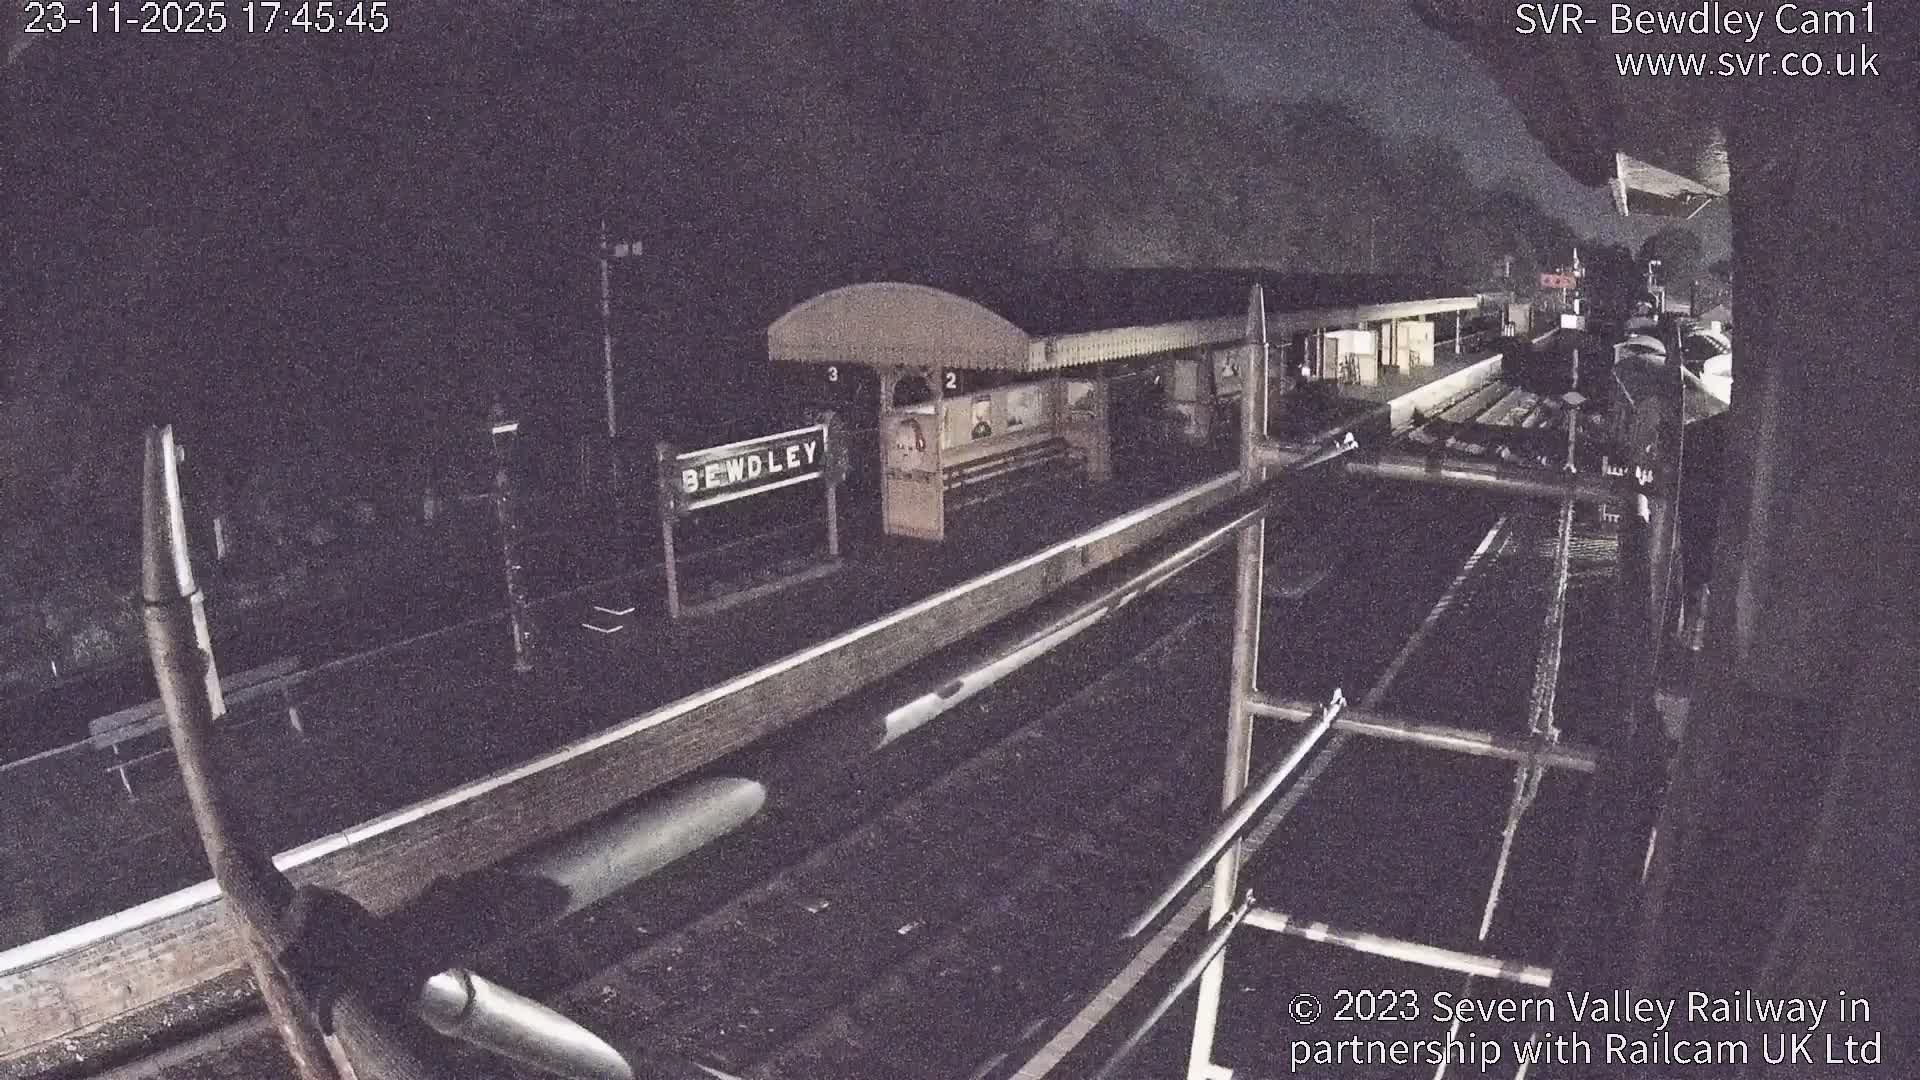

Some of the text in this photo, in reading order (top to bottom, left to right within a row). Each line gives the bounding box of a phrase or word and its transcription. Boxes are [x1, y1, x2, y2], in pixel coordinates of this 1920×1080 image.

[828, 366, 838, 381] 3
[946, 372, 956, 388] 2
[682, 440, 816, 493] BEWDLEY
